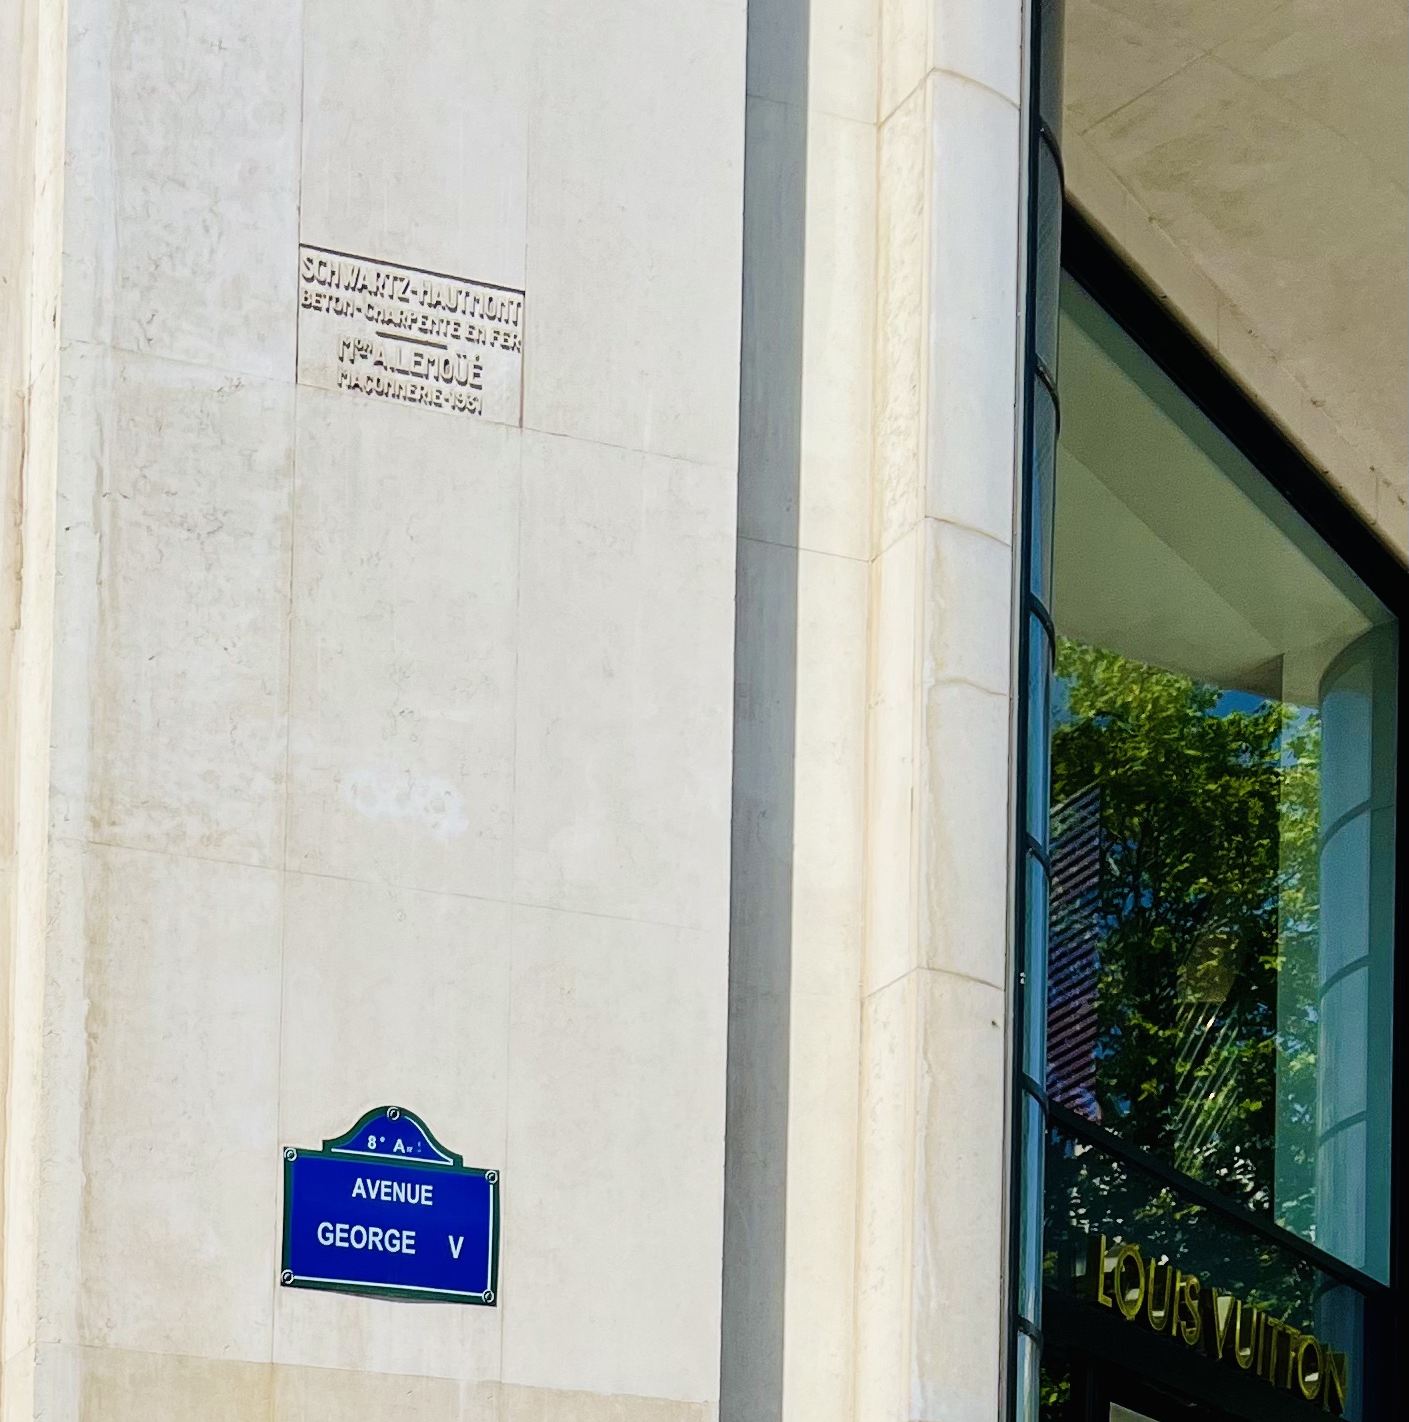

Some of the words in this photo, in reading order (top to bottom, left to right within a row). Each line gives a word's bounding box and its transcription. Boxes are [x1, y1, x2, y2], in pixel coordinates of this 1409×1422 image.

[465, 322, 486, 346] EN
[490, 328, 521, 353] FER
[351, 1177, 433, 1205] AVENUE
[317, 1221, 416, 1254] GEORGE
[448, 1235, 464, 1259] V
[1097, 1234, 1201, 1345] LOUIS
[1212, 1287, 1347, 1417] VUITTON
